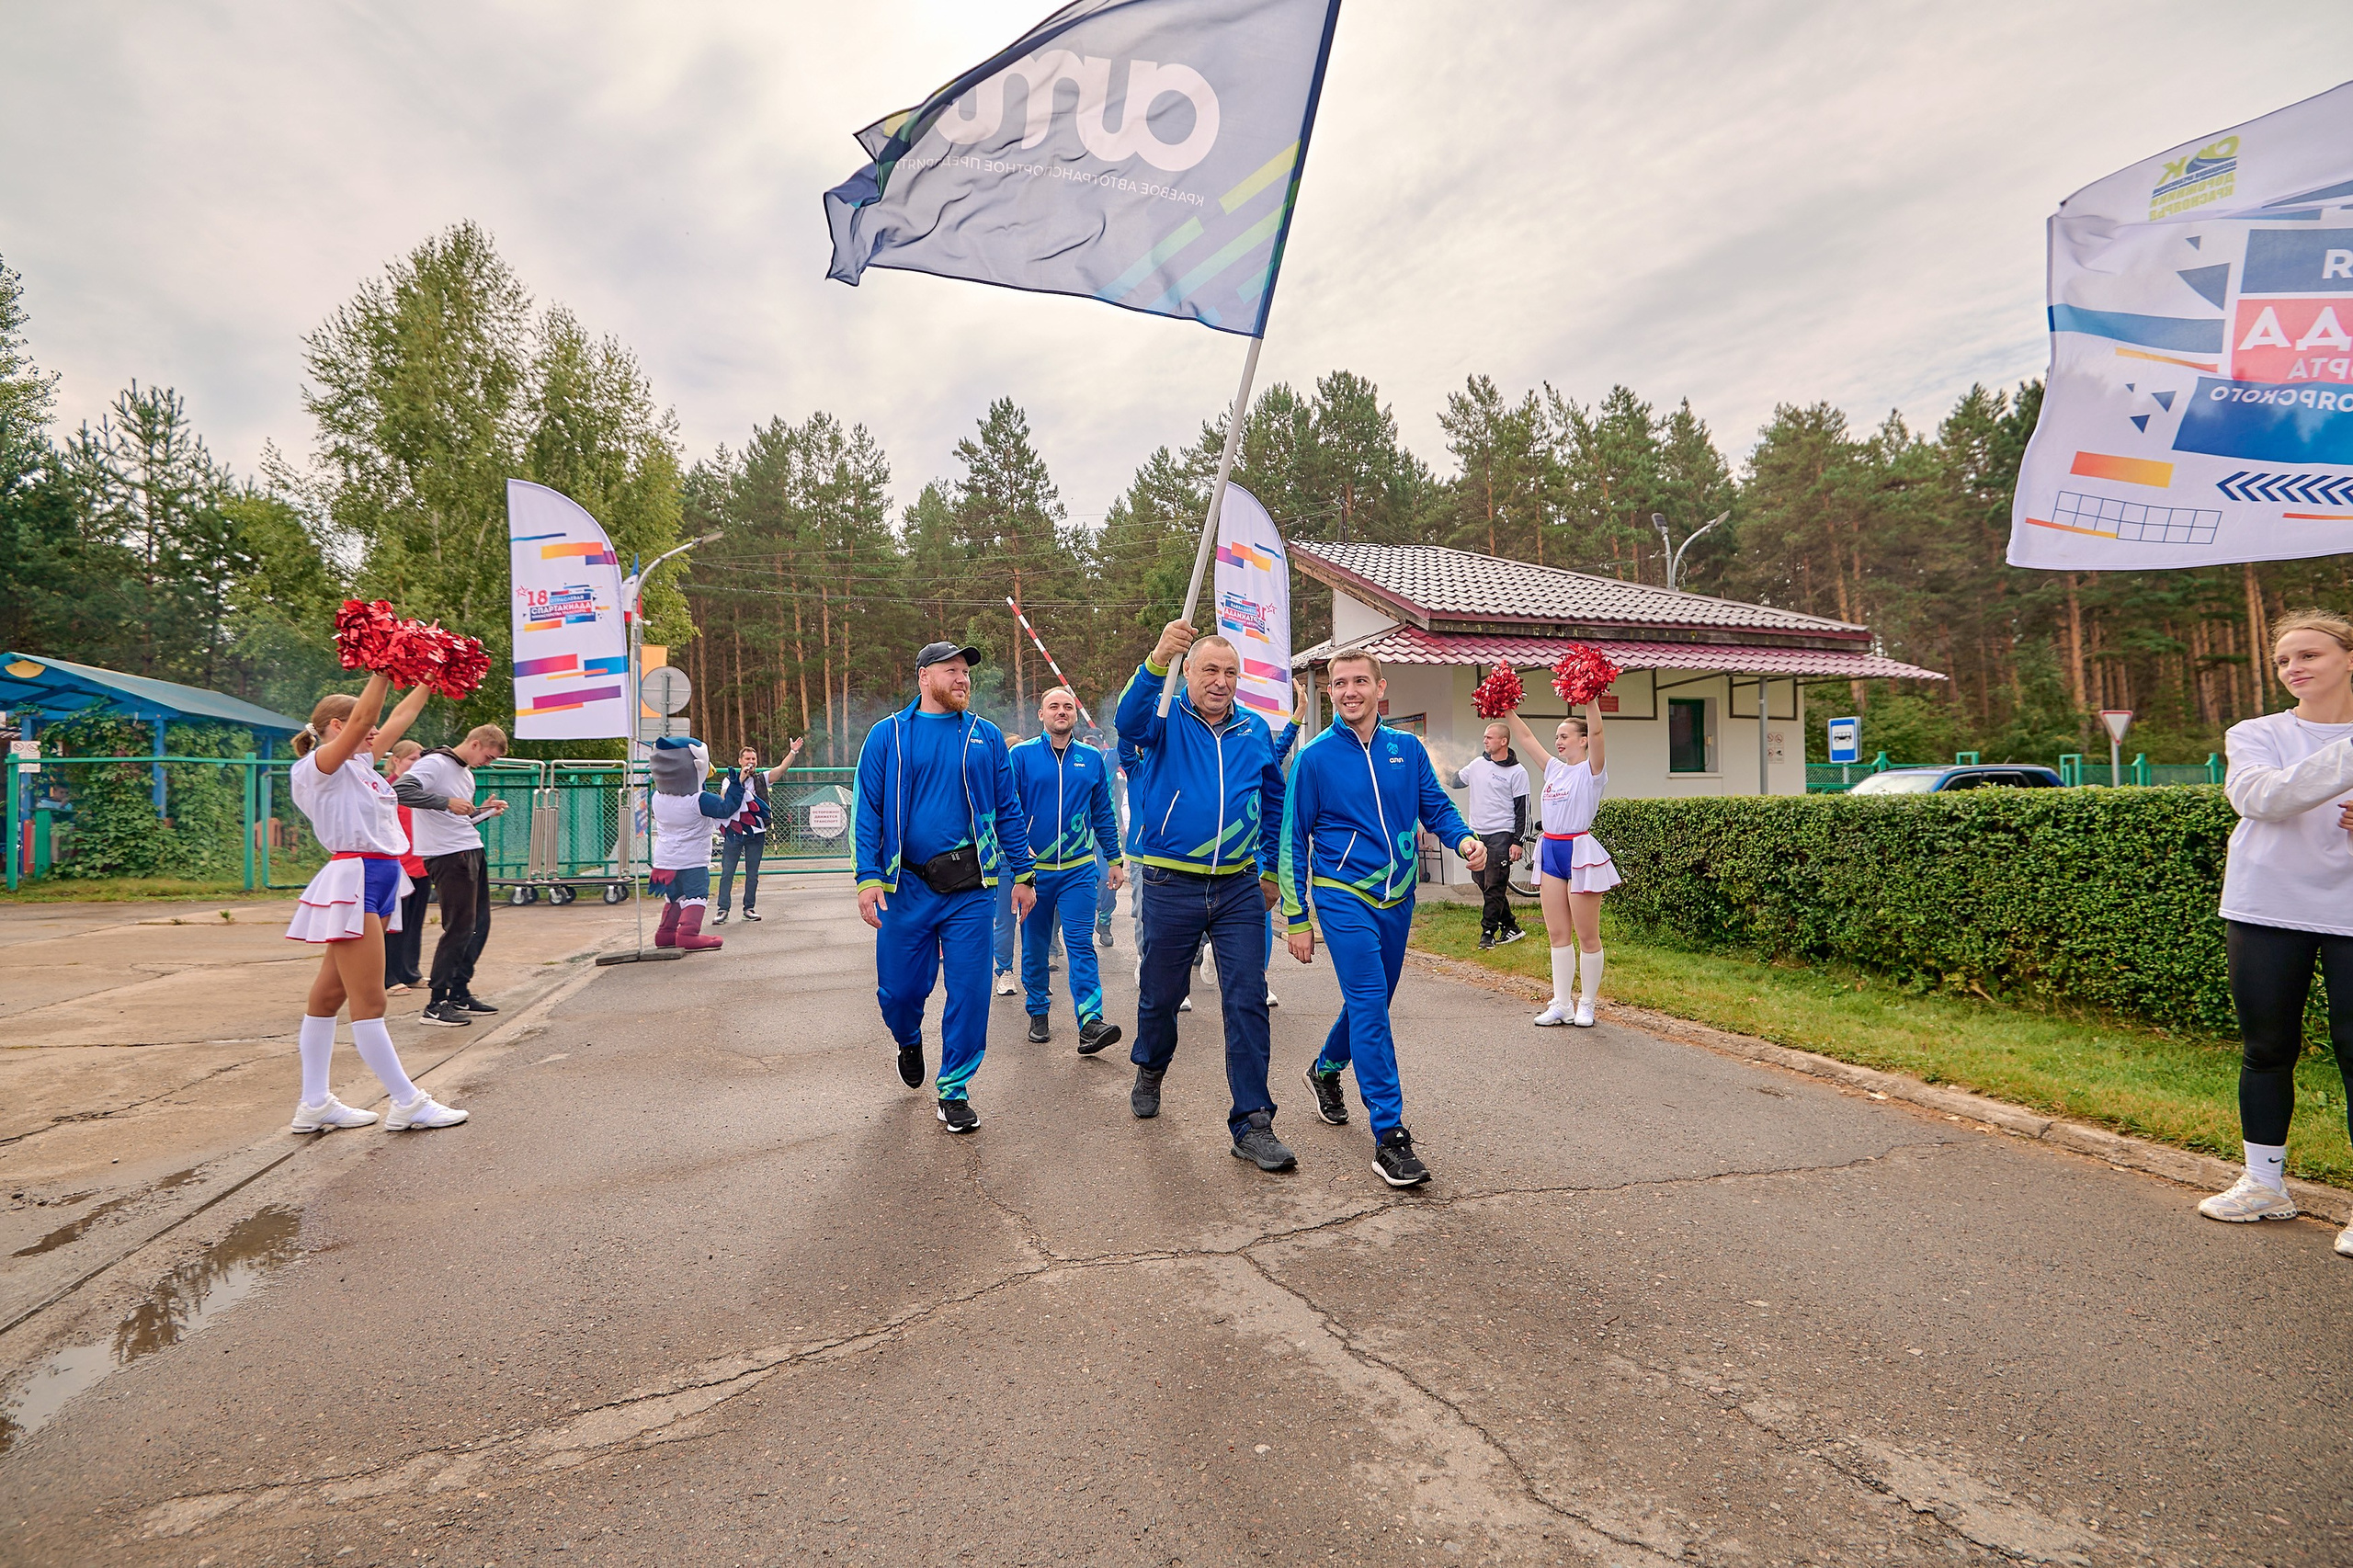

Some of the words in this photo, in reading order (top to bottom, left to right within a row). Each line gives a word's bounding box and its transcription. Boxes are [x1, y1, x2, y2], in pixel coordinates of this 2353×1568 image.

[528, 589, 549, 607] 18
[550, 595, 585, 604] ОТРАСЛЕВАЯ
[531, 601, 592, 615] СПАРТАКИАДА
